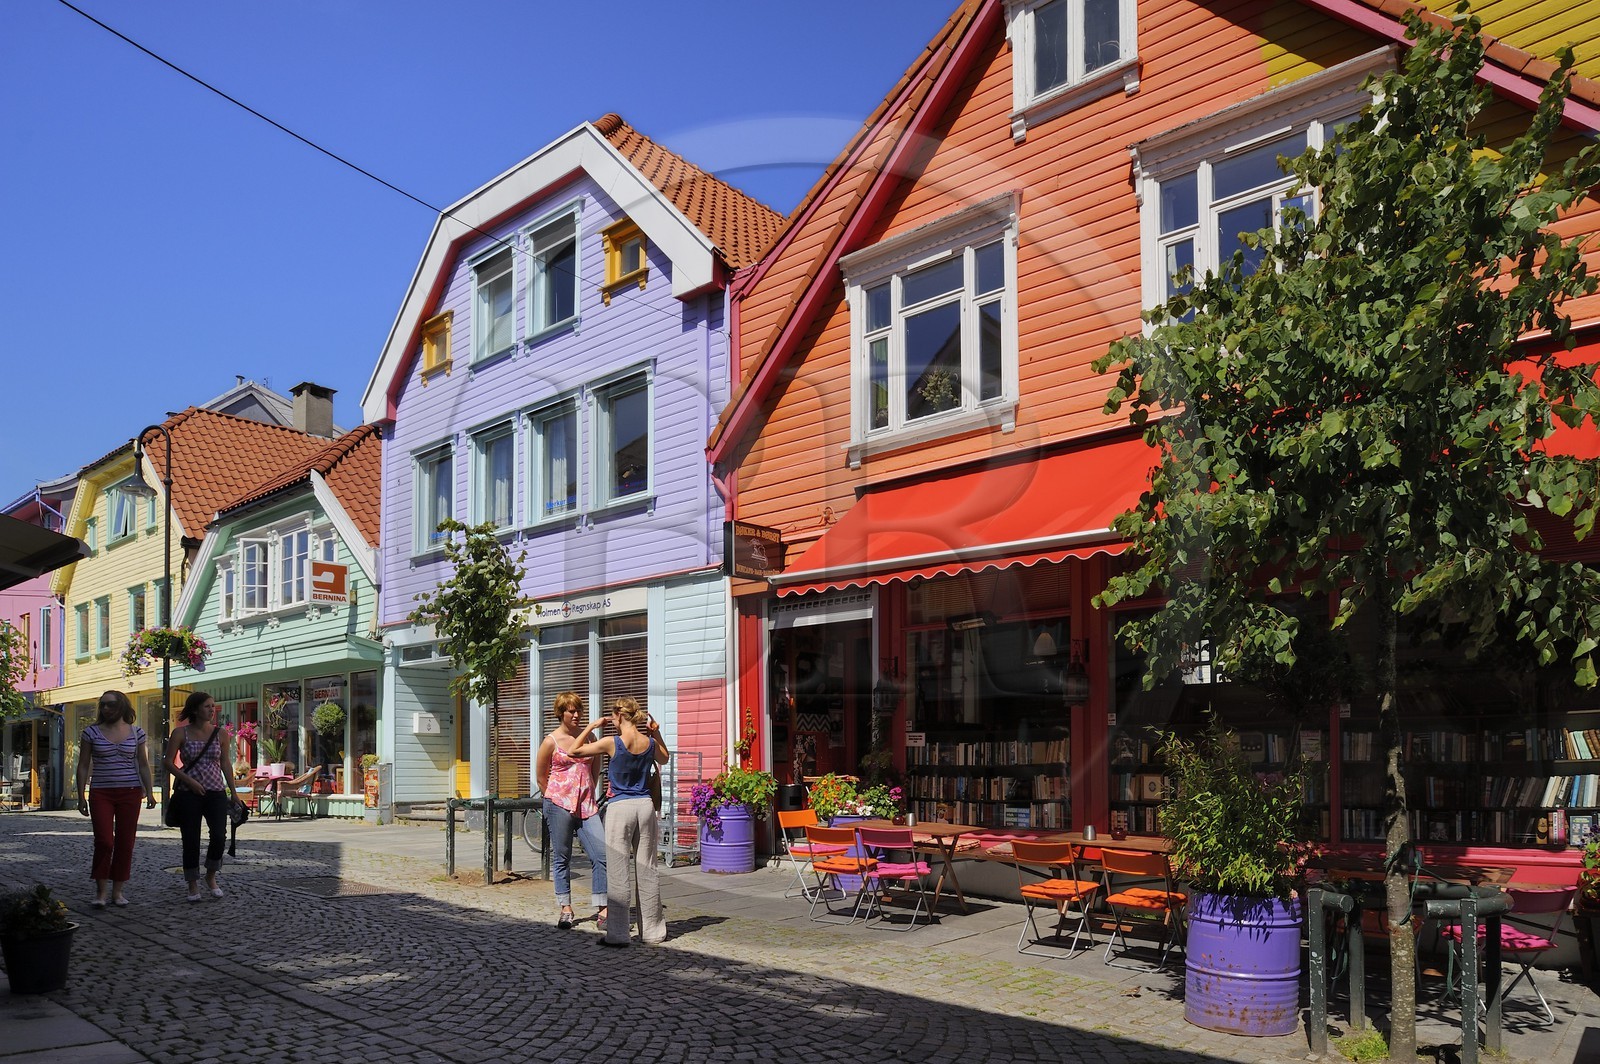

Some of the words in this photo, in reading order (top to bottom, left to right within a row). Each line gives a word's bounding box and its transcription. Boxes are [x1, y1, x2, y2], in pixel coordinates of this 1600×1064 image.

[735, 525, 755, 536] BØKER
[756, 529, 761, 537] &
[312, 593, 347, 602] BERNINA
[571, 601, 601, 614] Regnskap
[602, 598, 611, 608] AS
